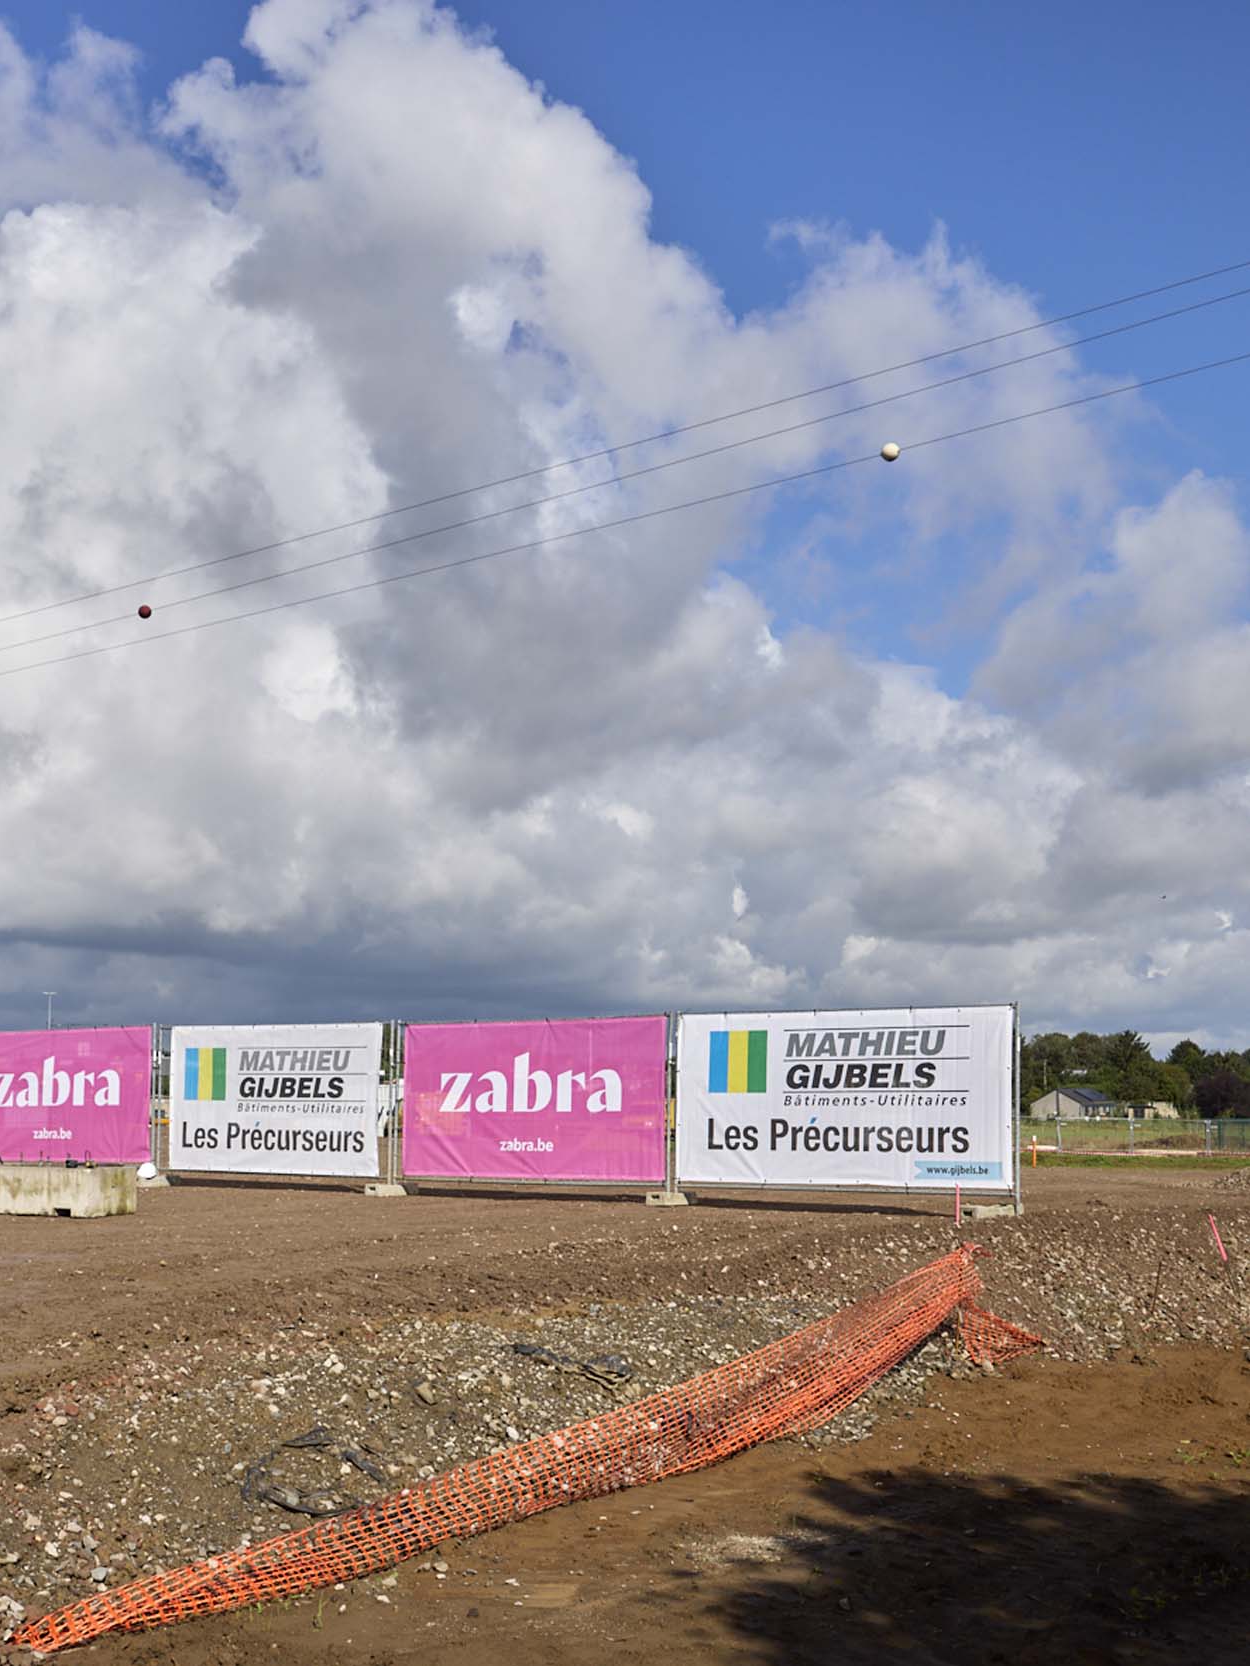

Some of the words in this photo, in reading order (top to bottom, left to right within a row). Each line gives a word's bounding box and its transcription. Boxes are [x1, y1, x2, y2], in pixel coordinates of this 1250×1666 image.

[785, 1029, 946, 1057] MATHIEU
[238, 1050, 351, 1073] MATHIEU
[439, 1052, 623, 1113] zabra
[786, 1062, 937, 1090] GIJBELS
[238, 1077, 344, 1099] GIJBELS
[237, 1102, 365, 1115] Bâtiments-Utilitaires
[783, 1094, 967, 1107] Bâtiments-Utilitaires
[33, 1127, 73, 1141] zabra.be
[181, 1121, 218, 1149] Les
[226, 1121, 365, 1153] Précurseurs
[500, 1138, 554, 1152] zabra.be
[707, 1118, 759, 1151] Les
[770, 1116, 970, 1153] Précurseurs
[926, 1165, 989, 1176] www.gijbels.be
